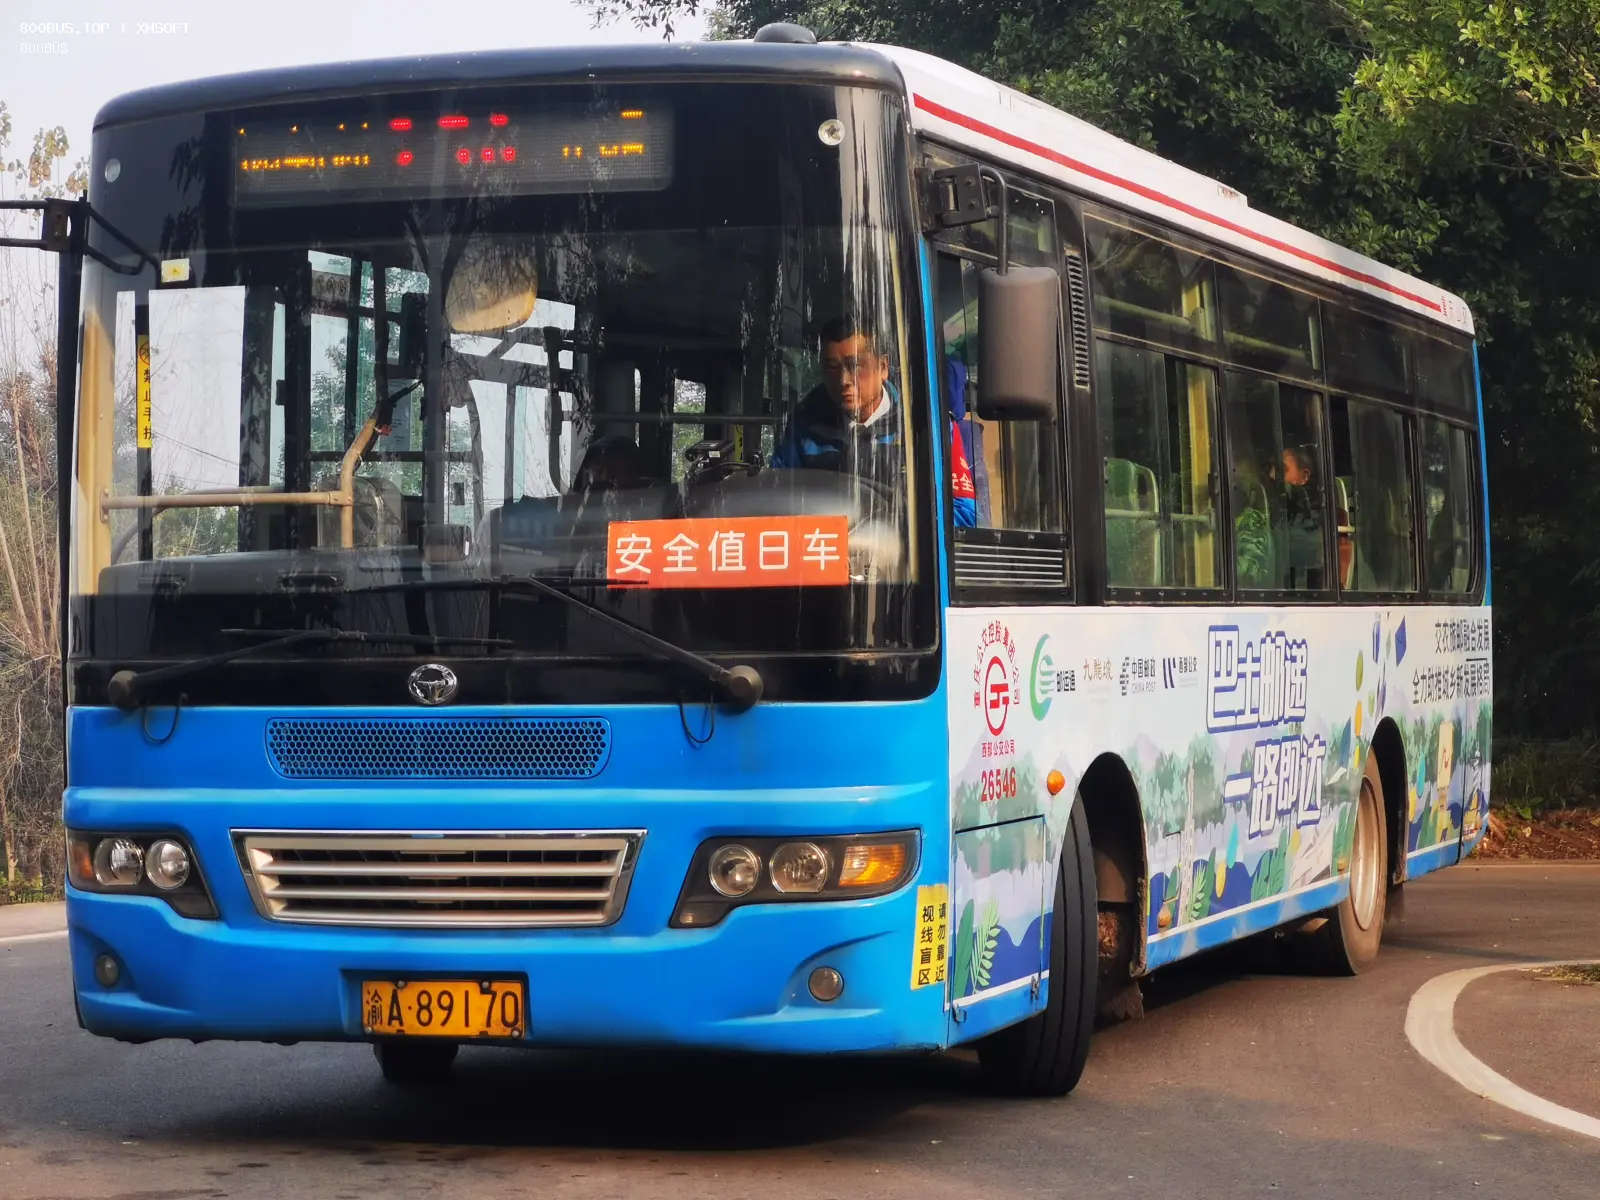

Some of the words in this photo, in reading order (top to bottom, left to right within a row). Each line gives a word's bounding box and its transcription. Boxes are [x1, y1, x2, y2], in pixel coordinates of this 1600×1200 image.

[615, 527, 841, 574] 安全值日车
[1131, 658, 1156, 680] 中国邮政
[1145, 682, 1156, 693] POST
[1206, 624, 1308, 734] 巴士邮递
[980, 739, 1015, 758] 西部公交公司
[980, 767, 1017, 802] 26546
[1223, 733, 1326, 840] 一路即达
[917, 905, 935, 986] 视线盲区
[934, 902, 947, 982] 请勿靠近
